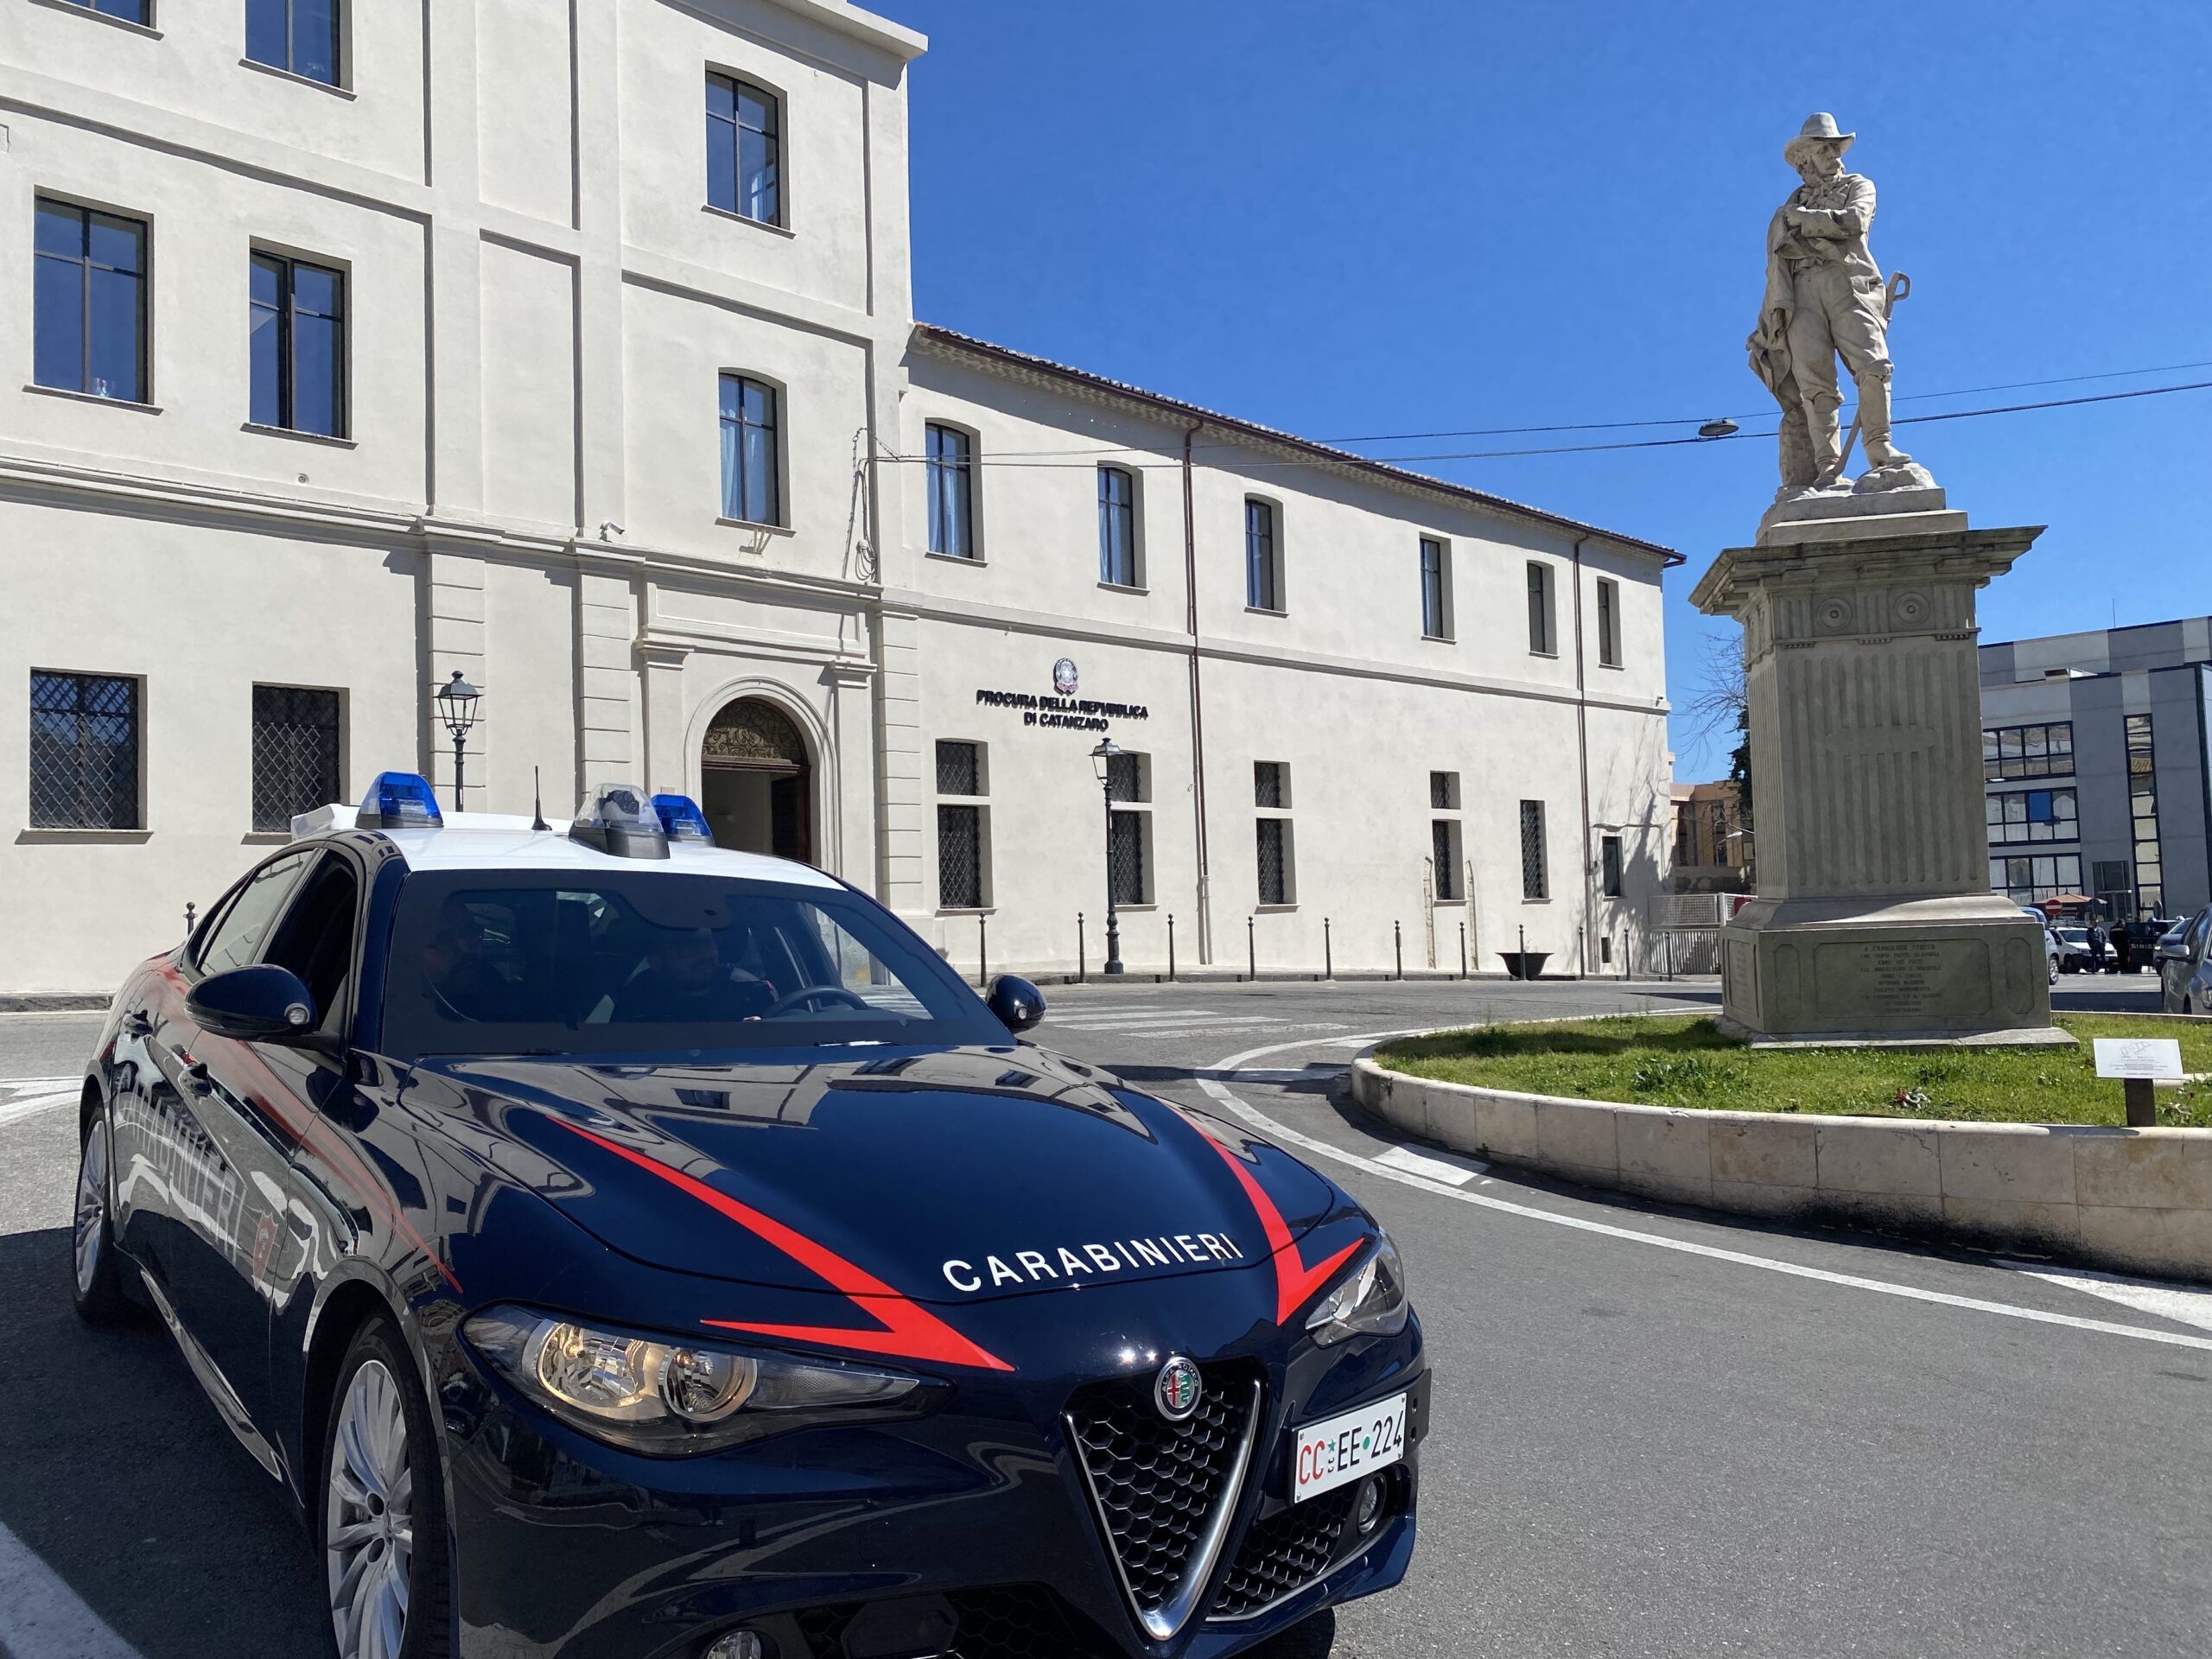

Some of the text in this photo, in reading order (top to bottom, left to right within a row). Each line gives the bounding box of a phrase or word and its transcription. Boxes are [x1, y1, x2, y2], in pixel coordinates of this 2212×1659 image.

[976, 690, 1149, 719] PROCURA DELLA REPUBBLICA
[1024, 712, 1109, 731] DI CATANZARO
[942, 1232, 1243, 1293] CARABINIERI
[1177, 1363, 1198, 1387] ROMEO
[1371, 1409, 1403, 1459] 224
